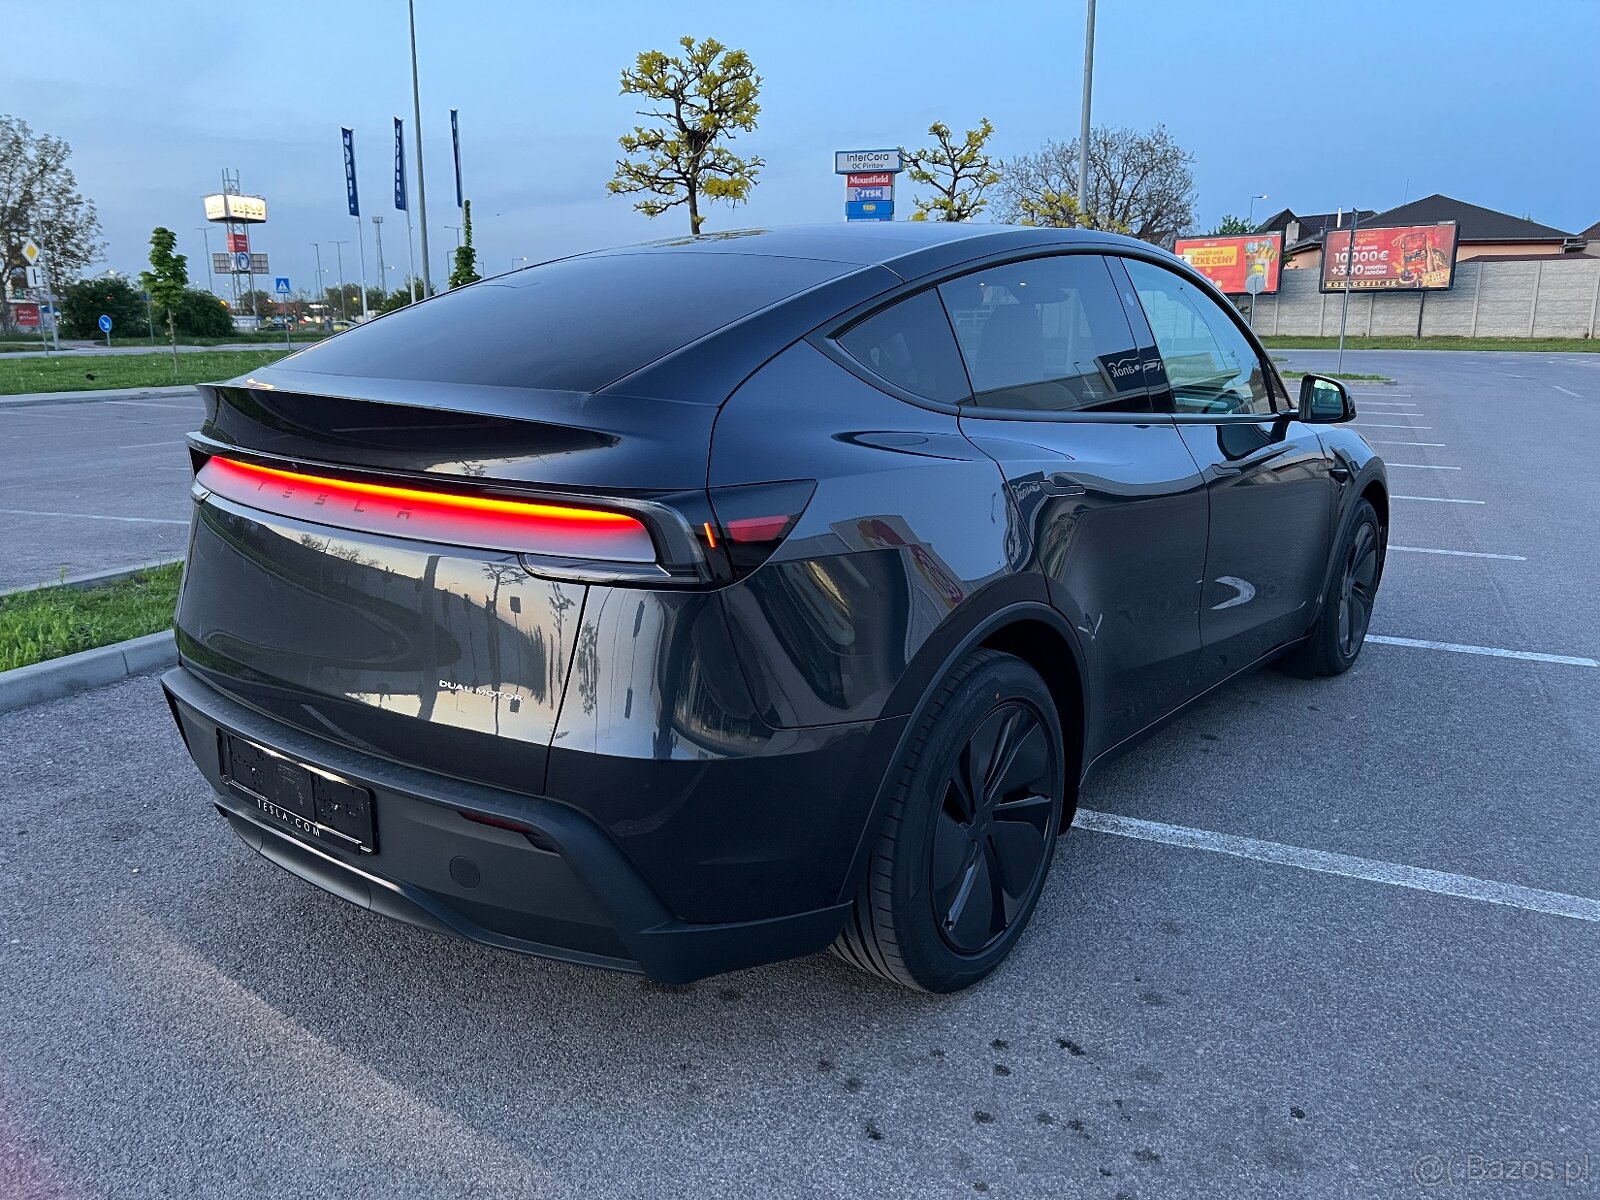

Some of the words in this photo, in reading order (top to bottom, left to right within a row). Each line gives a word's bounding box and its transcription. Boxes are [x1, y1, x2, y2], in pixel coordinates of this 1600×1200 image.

[847, 153, 889, 162] InterCora
[850, 175, 889, 184] Mountfield
[860, 190, 882, 198] JYSK
[1211, 255, 1234, 264] CENY
[1326, 280, 1397, 288] MONCOBET.SK
[257, 481, 413, 520] TESLA
[438, 679, 473, 693] DUAL
[475, 687, 524, 702] MOTOR
[257, 799, 321, 837] TESLA.COM
